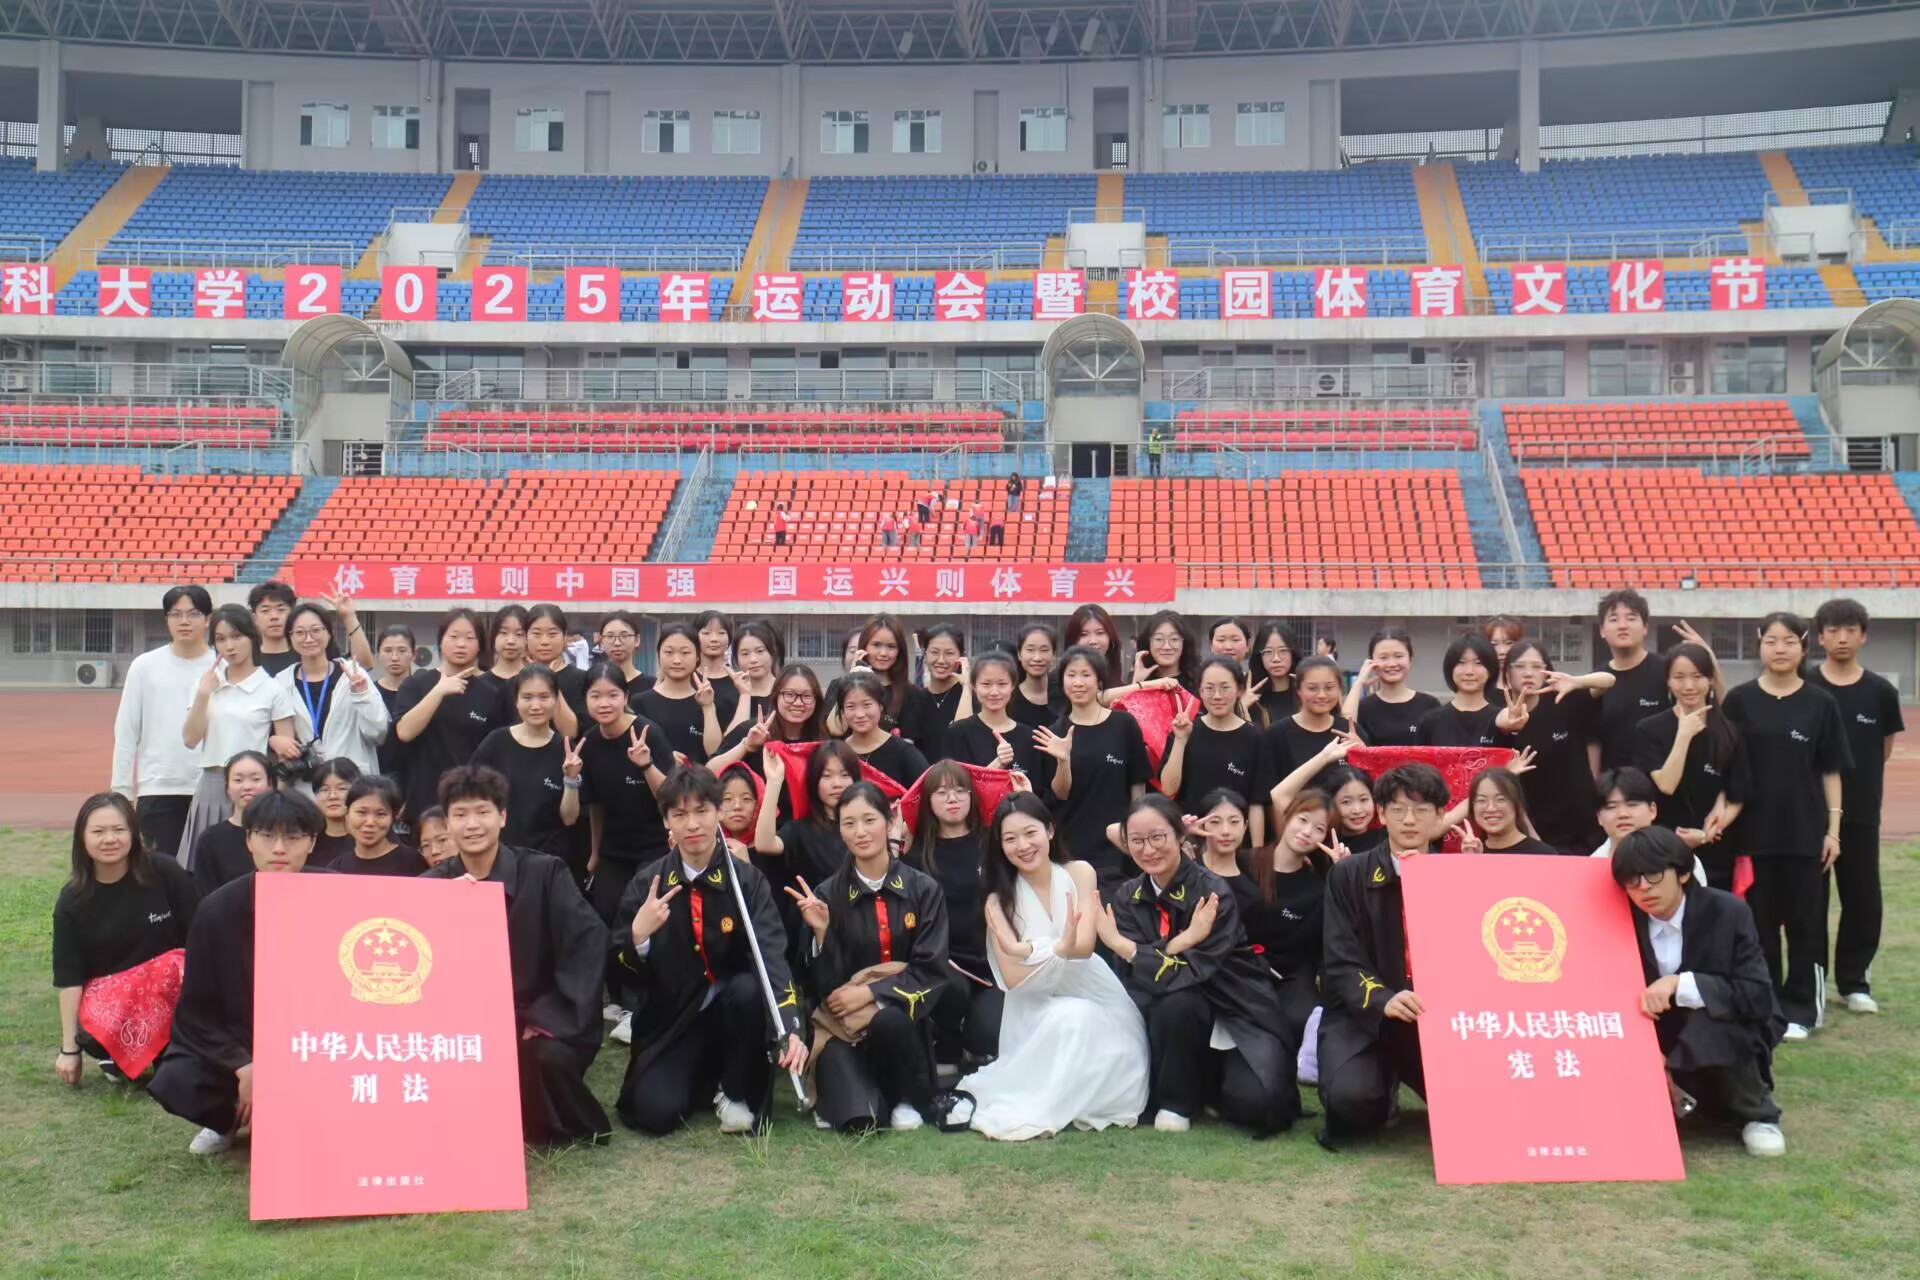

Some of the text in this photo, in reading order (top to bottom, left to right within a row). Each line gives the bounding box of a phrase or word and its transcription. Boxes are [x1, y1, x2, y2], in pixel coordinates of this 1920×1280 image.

[335, 564, 1136, 599] 体育强则中国强 国运兴则体育兴
[1451, 1011, 1625, 1040] 中华人民共和国
[291, 1031, 483, 1063] 中华人民共和国
[1508, 1049, 1581, 1079] 宪法
[349, 1073, 430, 1103] 刑法
